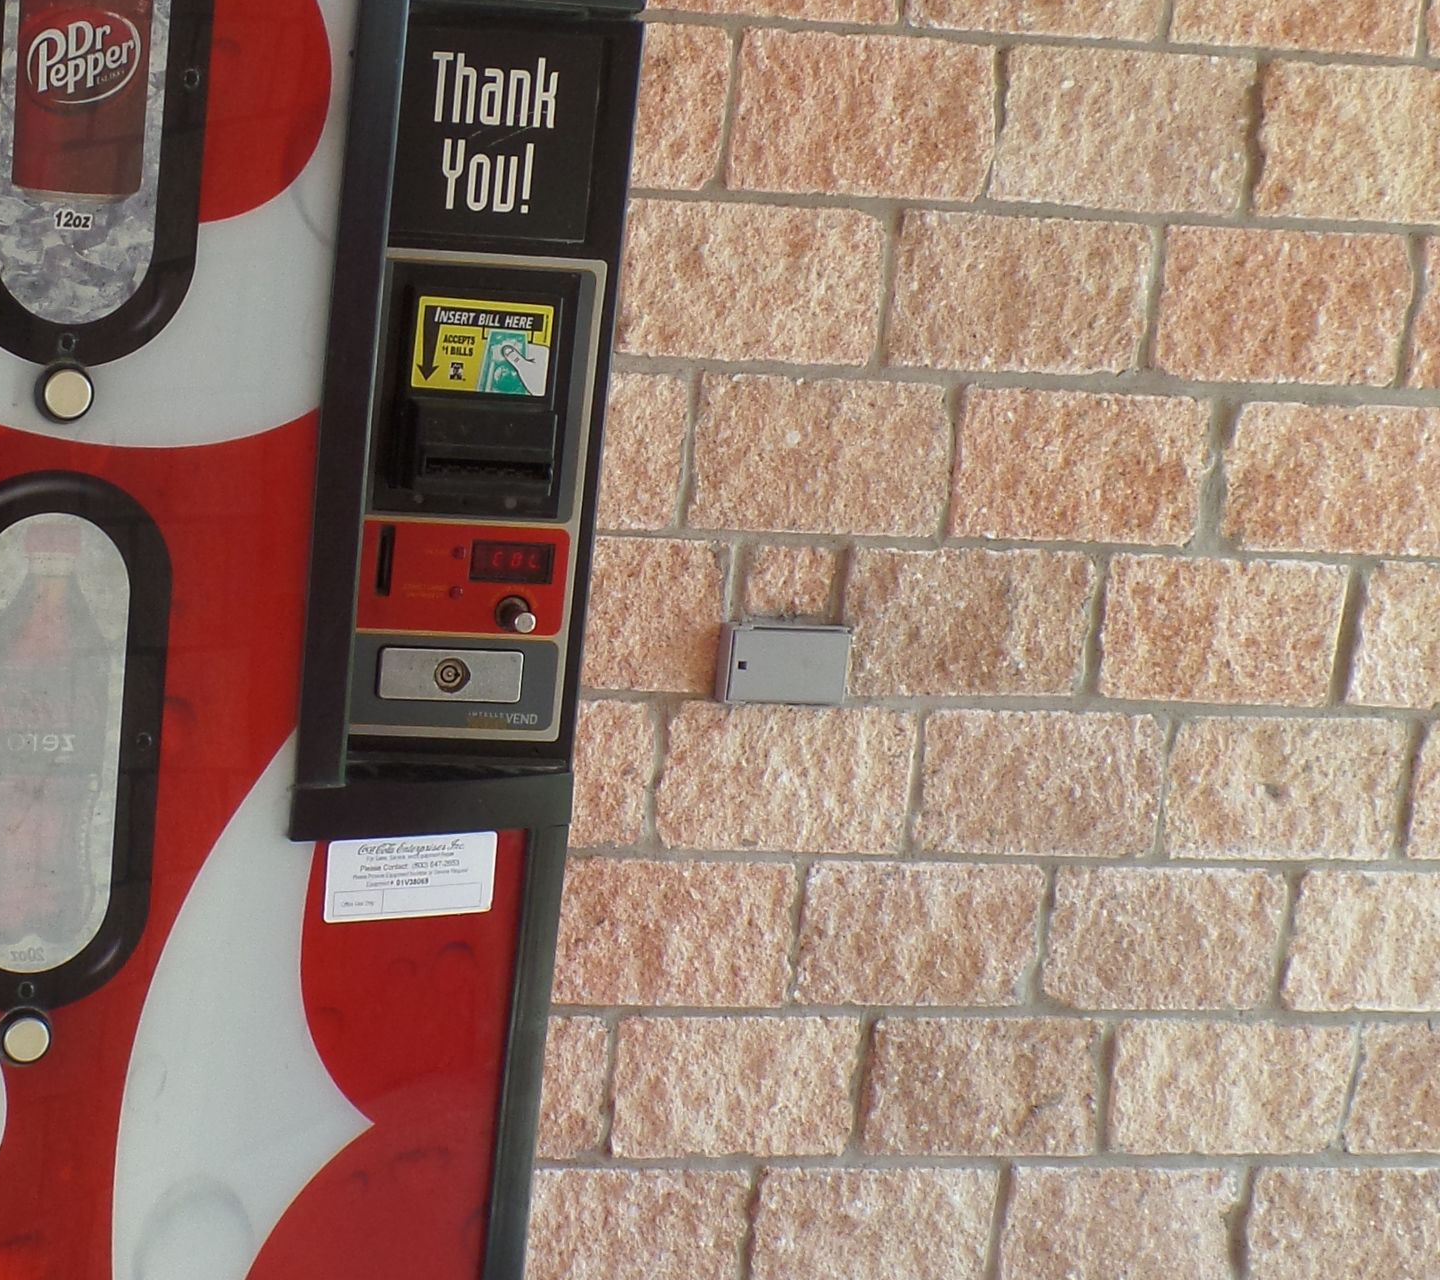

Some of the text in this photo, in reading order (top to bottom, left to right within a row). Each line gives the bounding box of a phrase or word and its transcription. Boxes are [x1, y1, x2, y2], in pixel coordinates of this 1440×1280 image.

[67, 20, 111, 59] Dr
[27, 28, 135, 95] Pepper
[432, 51, 559, 129] Thank
[441, 138, 535, 214] You!
[54, 210, 93, 231] 12oz
[434, 307, 476, 325] INSERT
[478, 313, 501, 327] BILL
[504, 315, 534, 329] HERE
[443, 334, 475, 346] ACCEPTS
[450, 346, 474, 357] BILLS
